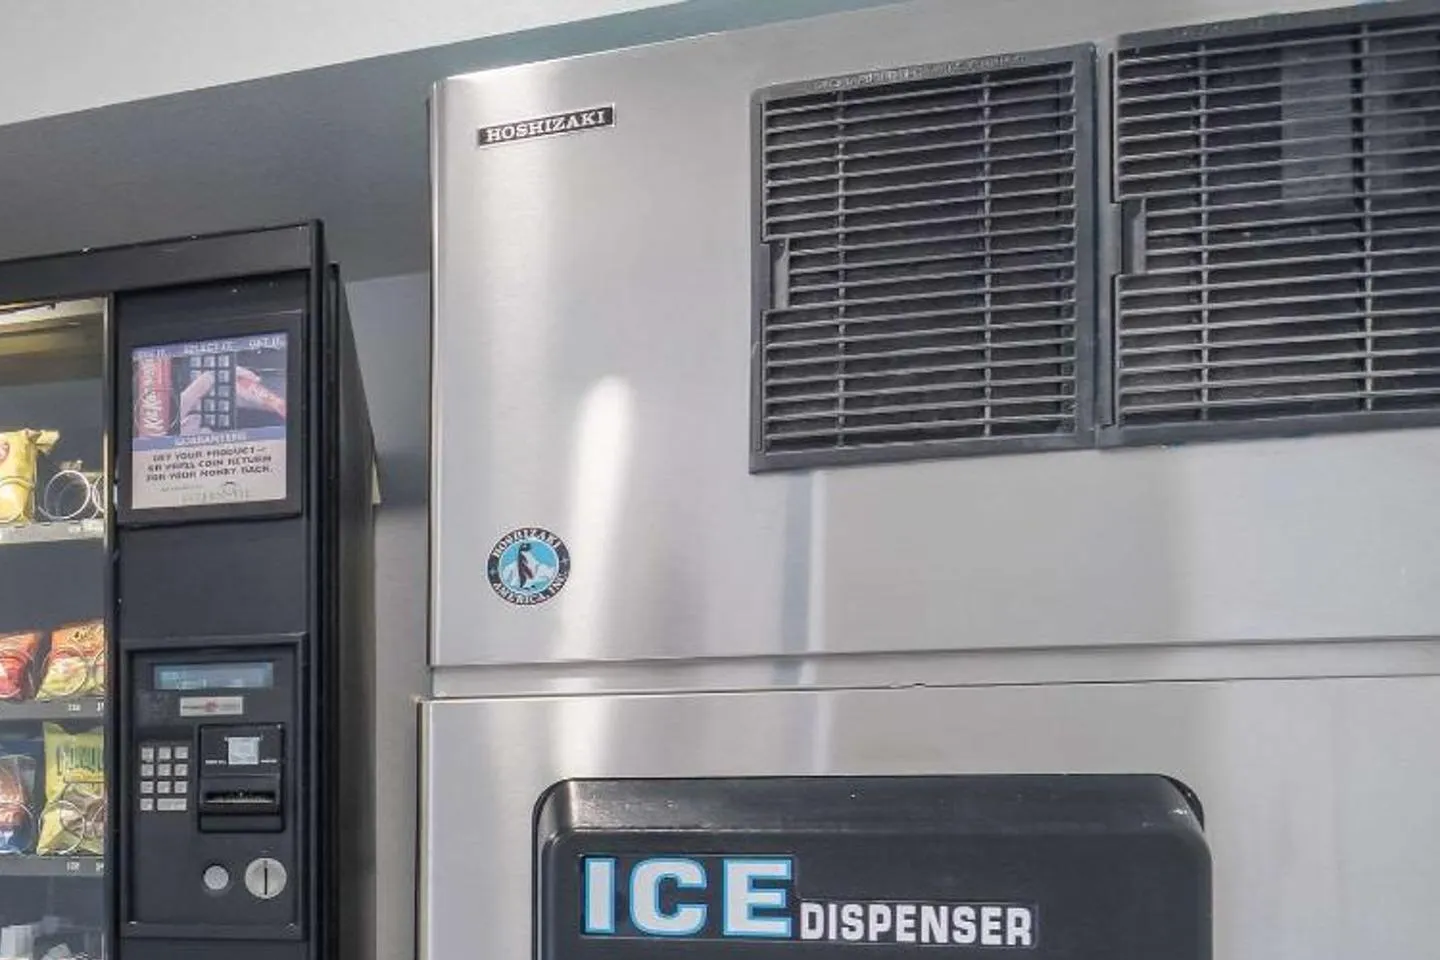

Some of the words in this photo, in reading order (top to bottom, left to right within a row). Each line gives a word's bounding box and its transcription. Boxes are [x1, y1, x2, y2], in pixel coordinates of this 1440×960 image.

[486, 110, 606, 142] HOSHIZAKI
[199, 459, 224, 469] COIN
[199, 467, 236, 478] MONEY
[583, 856, 793, 938] ICE
[799, 902, 1032, 945] DISPENSER
